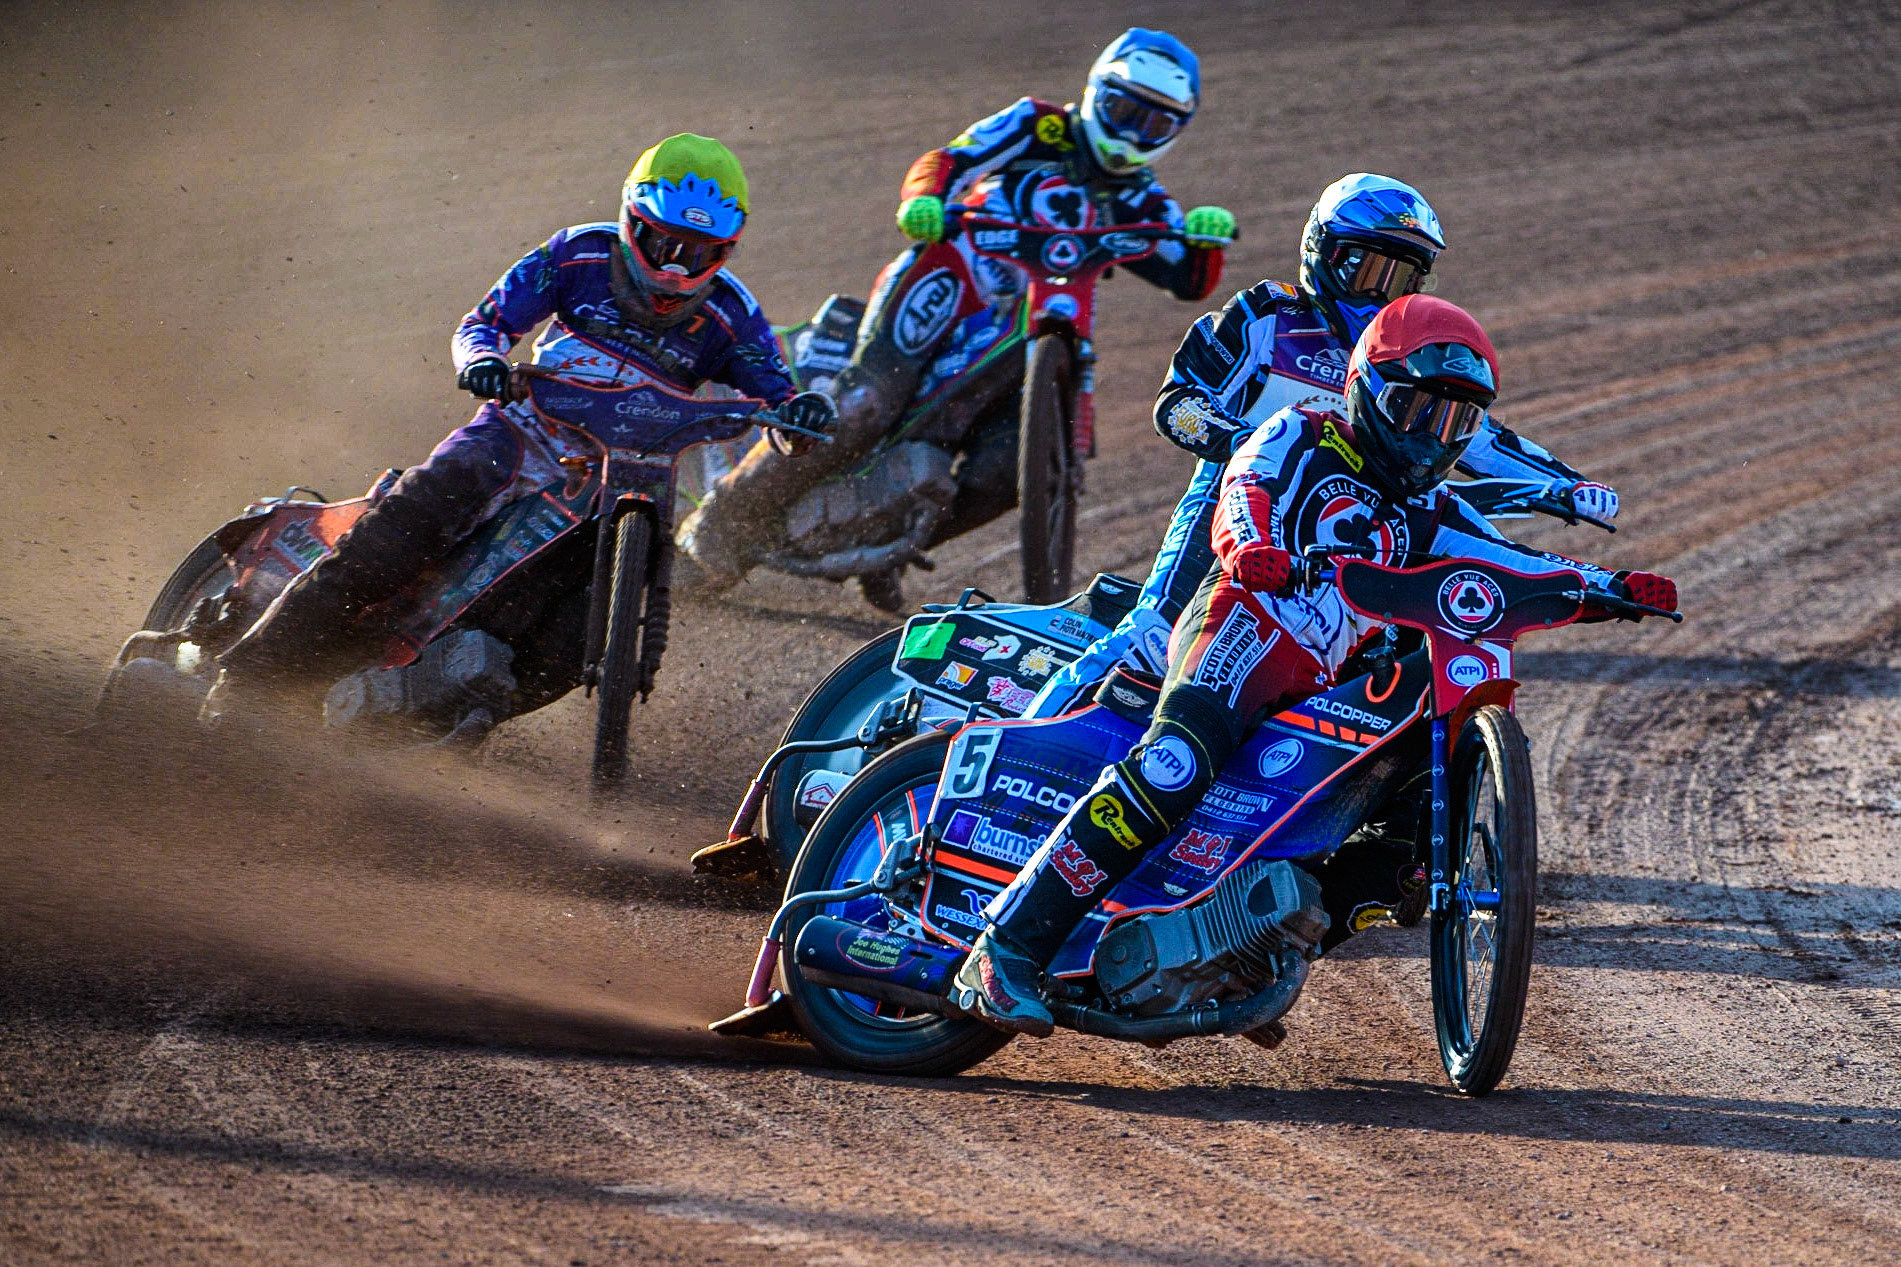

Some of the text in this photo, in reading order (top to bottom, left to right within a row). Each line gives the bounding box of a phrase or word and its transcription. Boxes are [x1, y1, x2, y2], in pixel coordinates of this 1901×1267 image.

[1295, 354, 1346, 382] Cren
[614, 402, 681, 421] Crendon
[1318, 481, 1356, 502] BELLE
[1363, 491, 1381, 510] VU
[1442, 573, 1500, 598] BELLE VUE ACES
[1454, 665, 1480, 677] ATPI
[1305, 695, 1392, 732] POLCOPPER
[952, 734, 994, 794] 5
[1150, 745, 1187, 778] ATPI
[1268, 749, 1294, 765] ATPI
[846, 944, 899, 966] International
[853, 938, 901, 956] Joe Hughes
